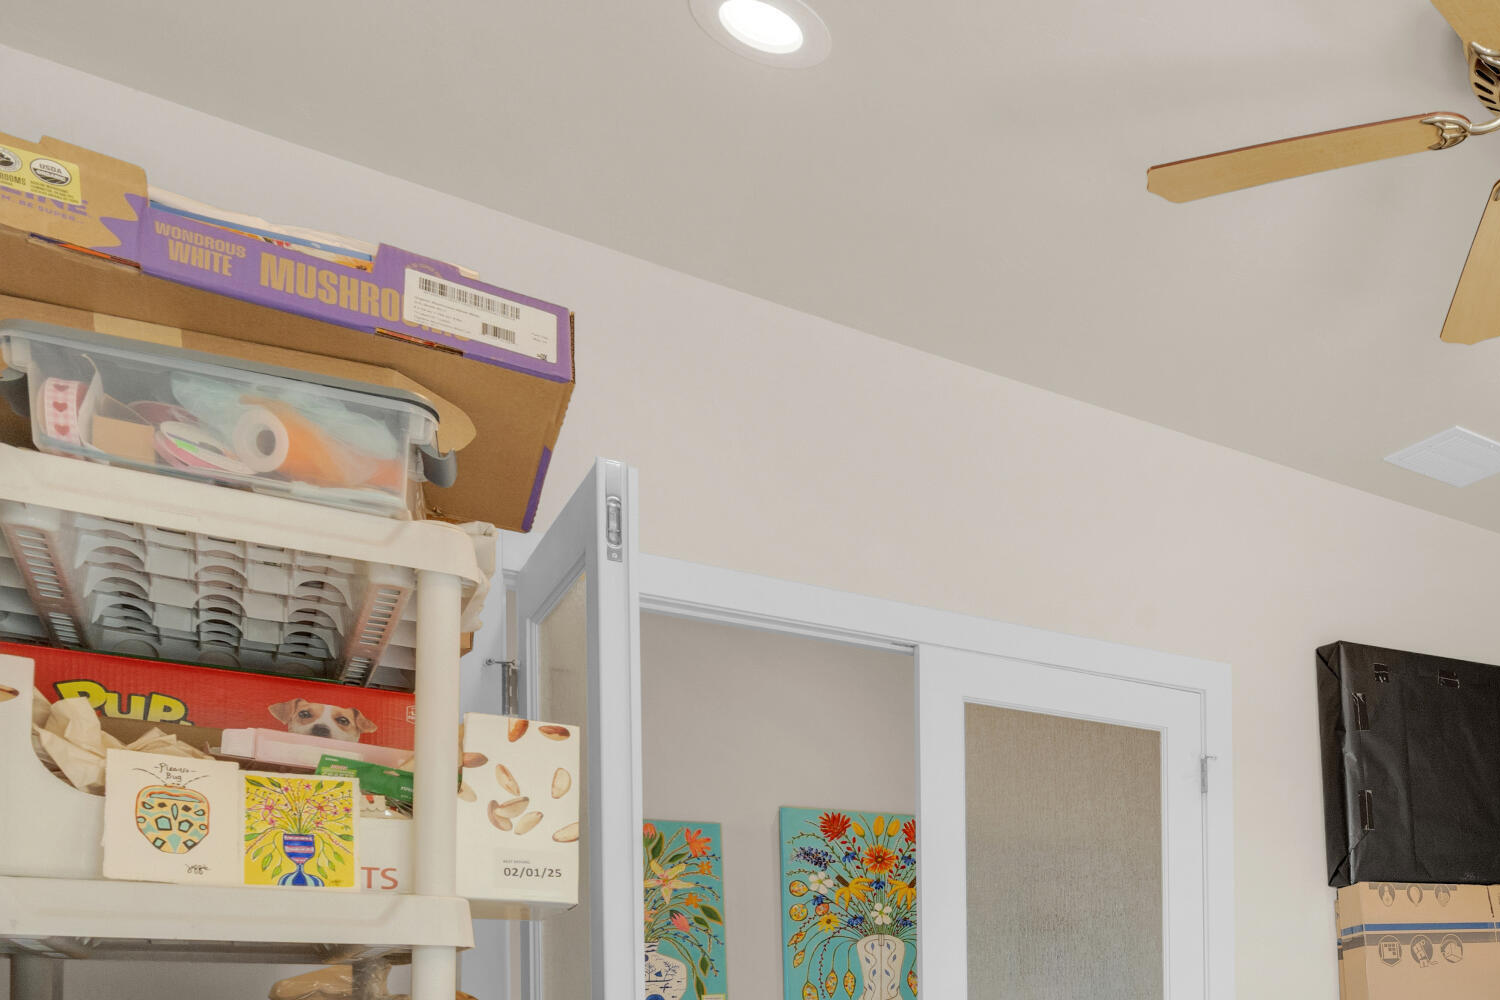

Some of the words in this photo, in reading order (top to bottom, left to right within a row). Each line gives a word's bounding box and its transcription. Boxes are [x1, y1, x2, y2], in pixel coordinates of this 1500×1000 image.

[154, 220, 247, 259] WONDROUS
[168, 239, 233, 277] WHITE
[503, 867, 562, 879] 02/01/25
